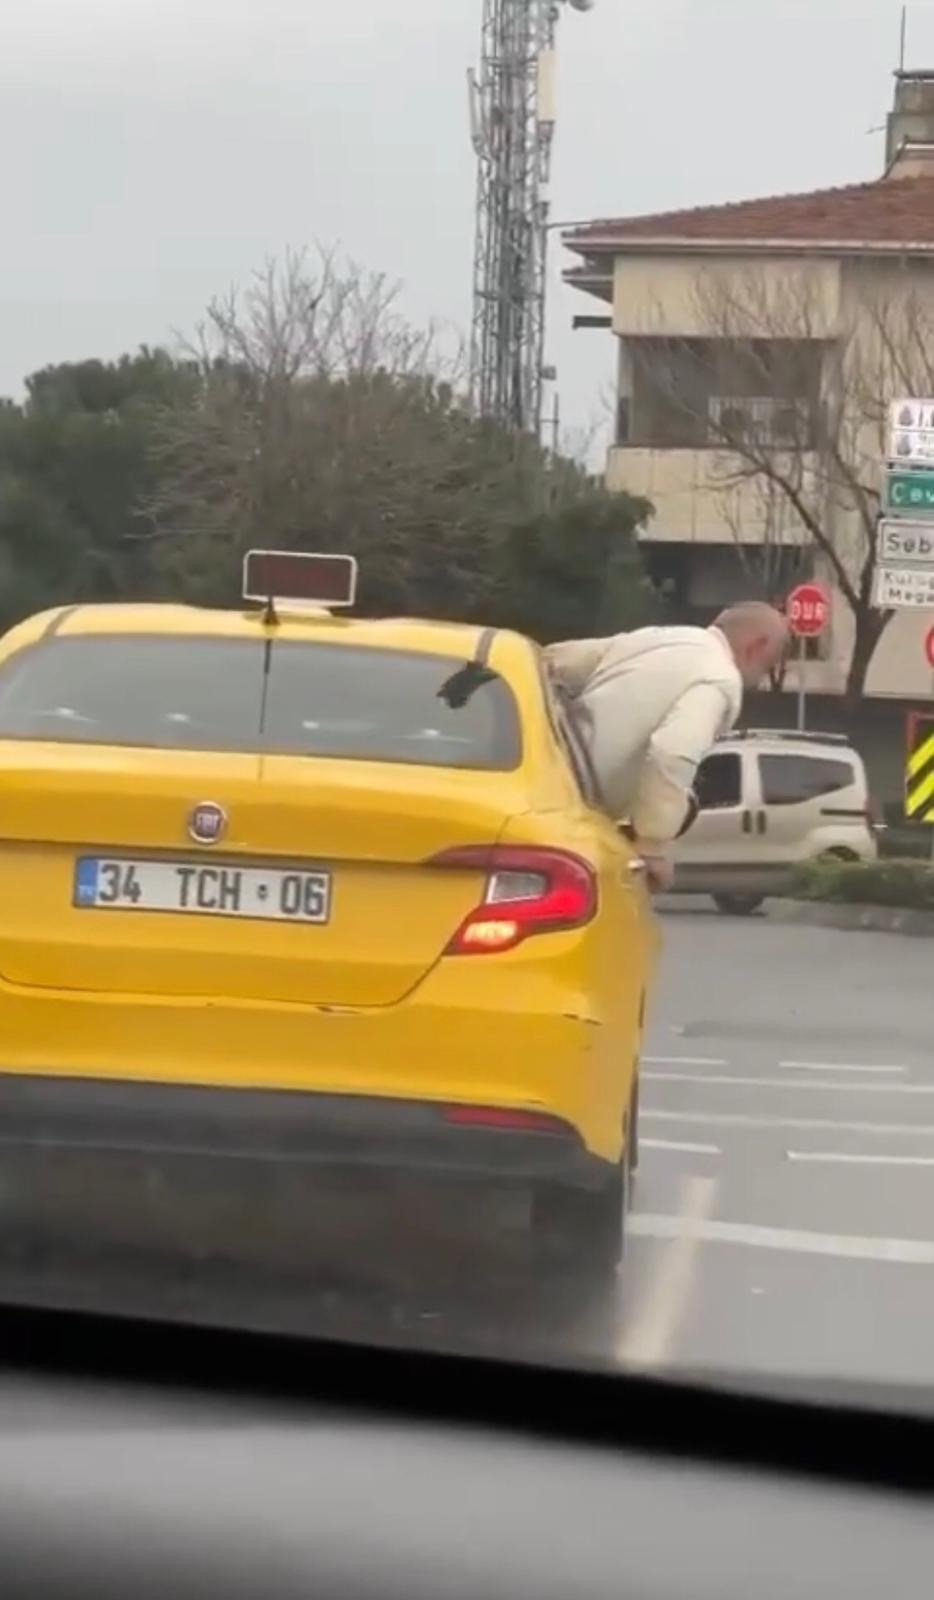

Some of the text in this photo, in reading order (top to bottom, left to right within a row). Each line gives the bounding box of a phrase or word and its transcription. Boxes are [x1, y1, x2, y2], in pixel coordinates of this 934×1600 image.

[792, 600, 826, 620] DUR
[99, 864, 325, 915] 34 TCH 06
